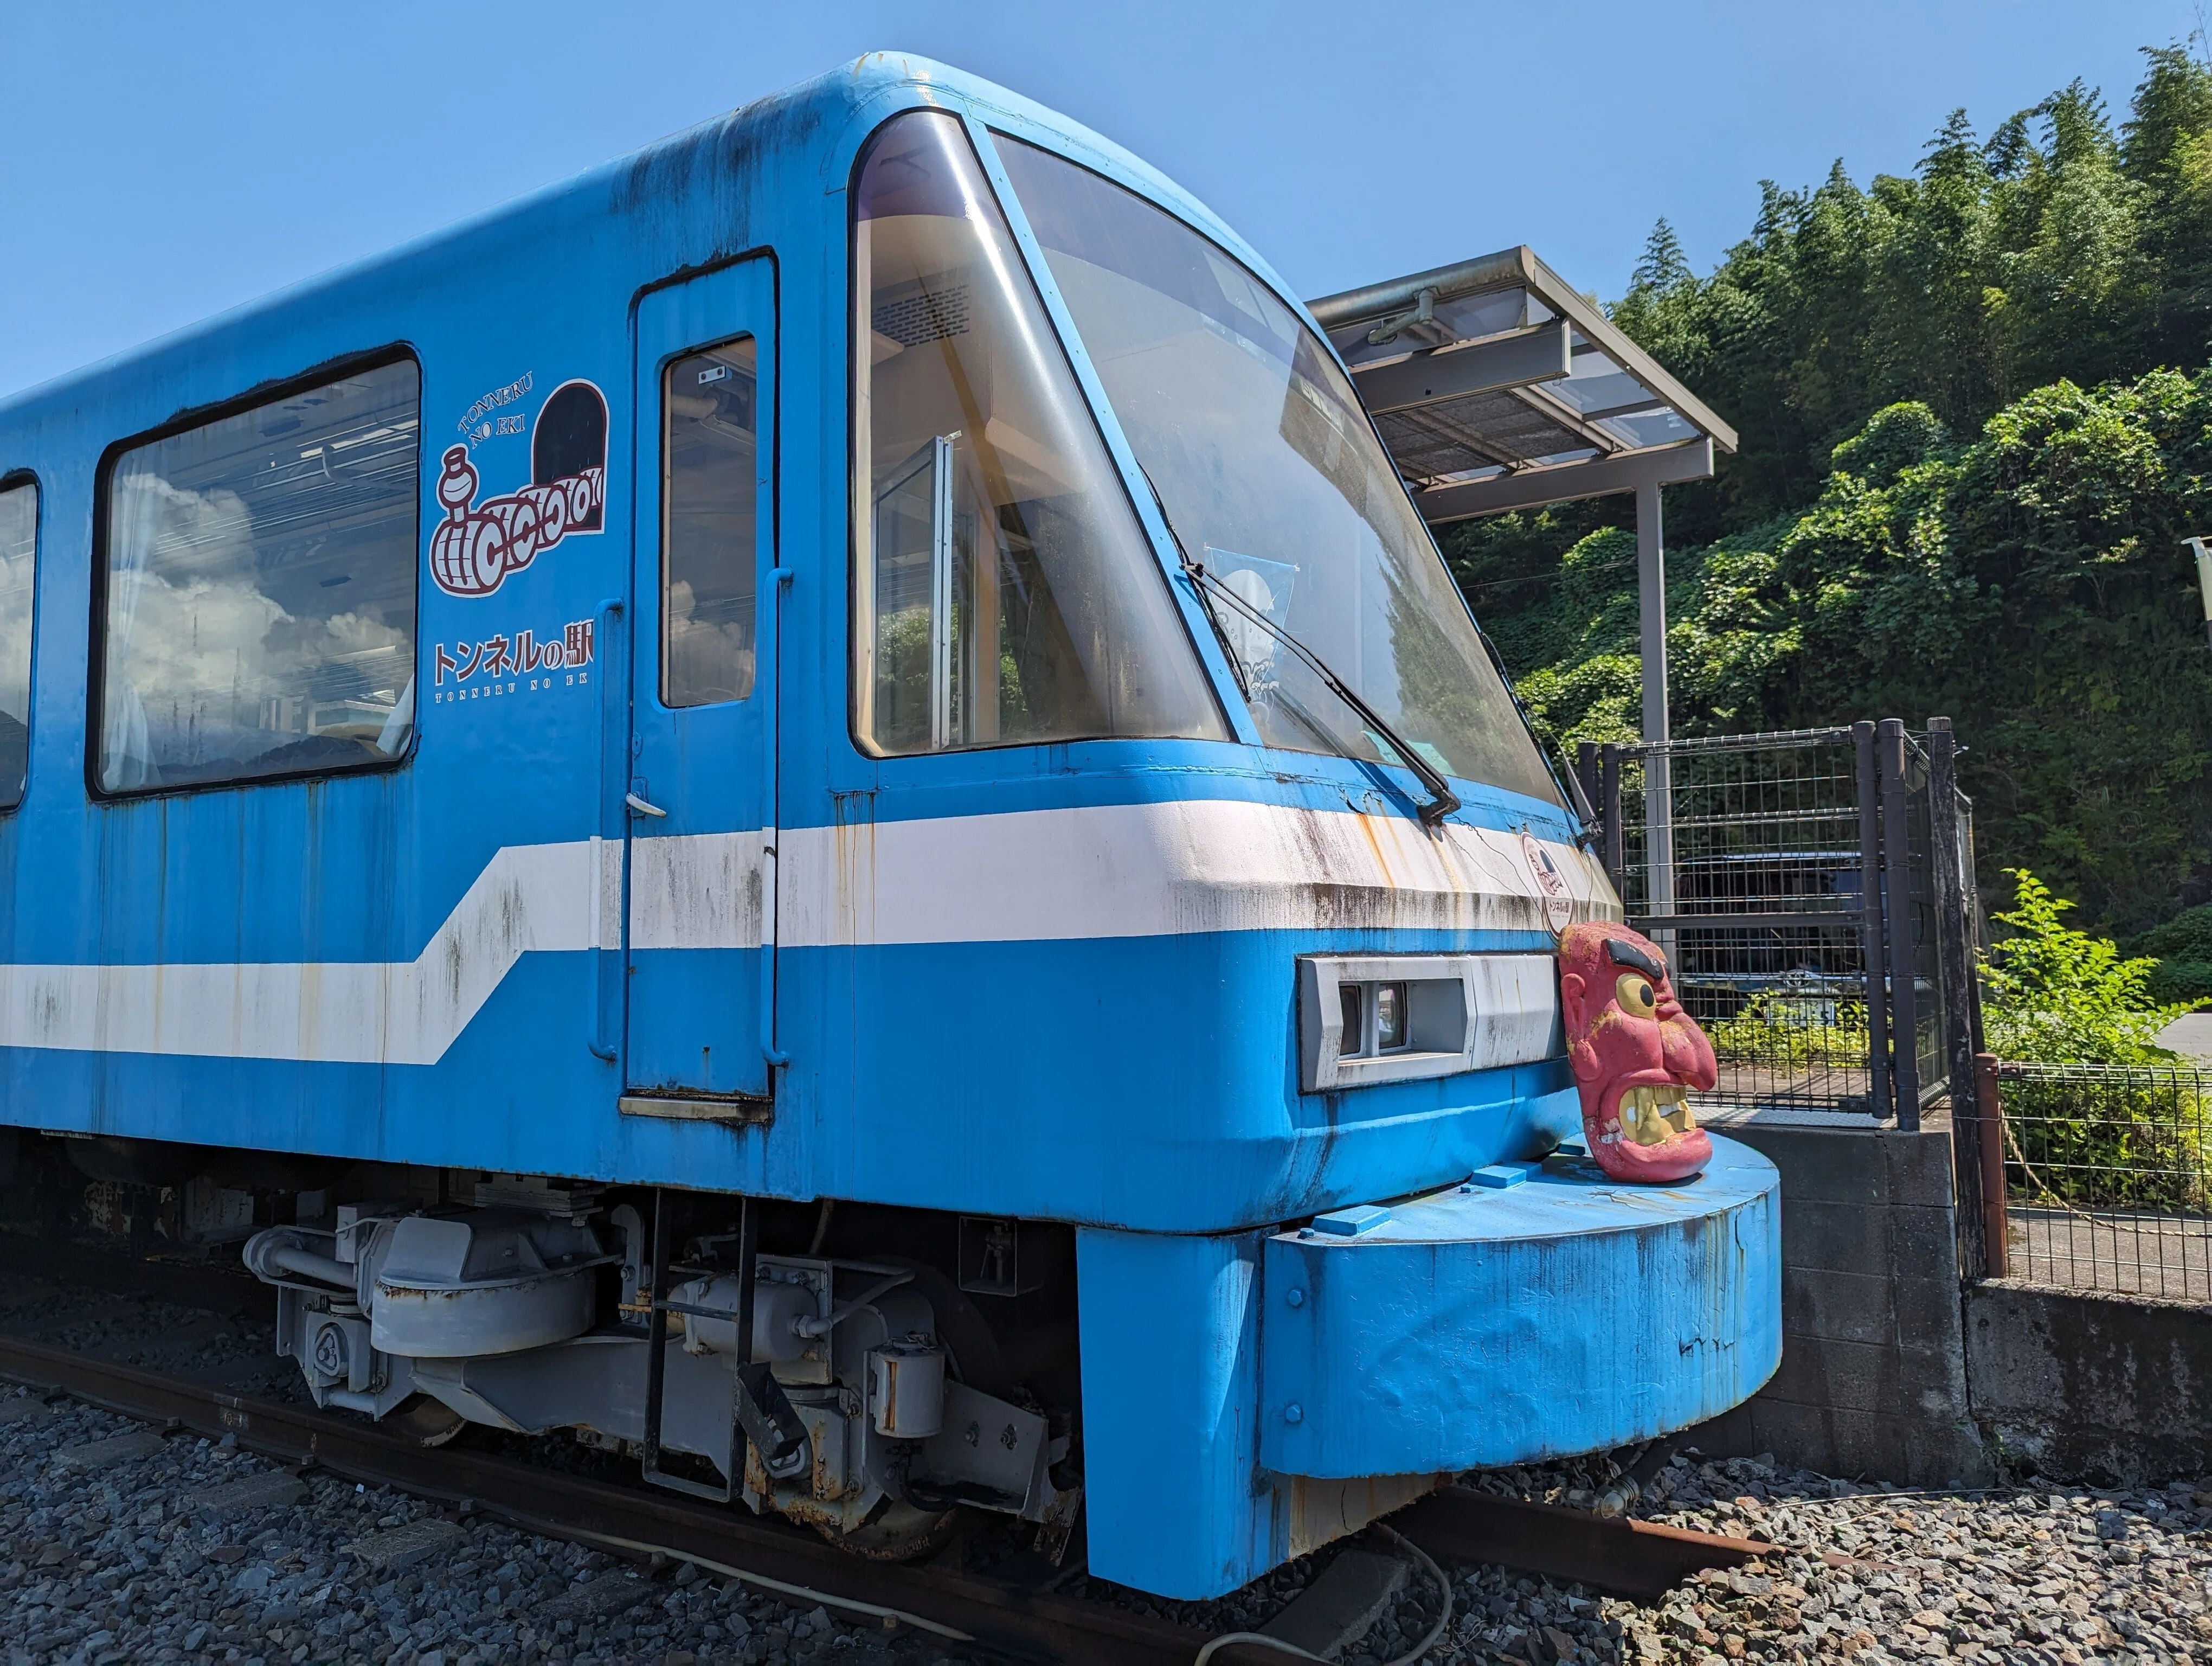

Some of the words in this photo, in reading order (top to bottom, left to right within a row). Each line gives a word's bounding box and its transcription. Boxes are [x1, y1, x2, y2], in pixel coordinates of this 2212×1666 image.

[457, 370, 533, 434] TONNERU
[469, 421, 492, 450] NO
[496, 413, 525, 435] EKI
[435, 619, 594, 686] トンネルの駅
[435, 682, 516, 703] TONNERU
[531, 678, 551, 691] NO
[566, 672, 587, 686] EK
